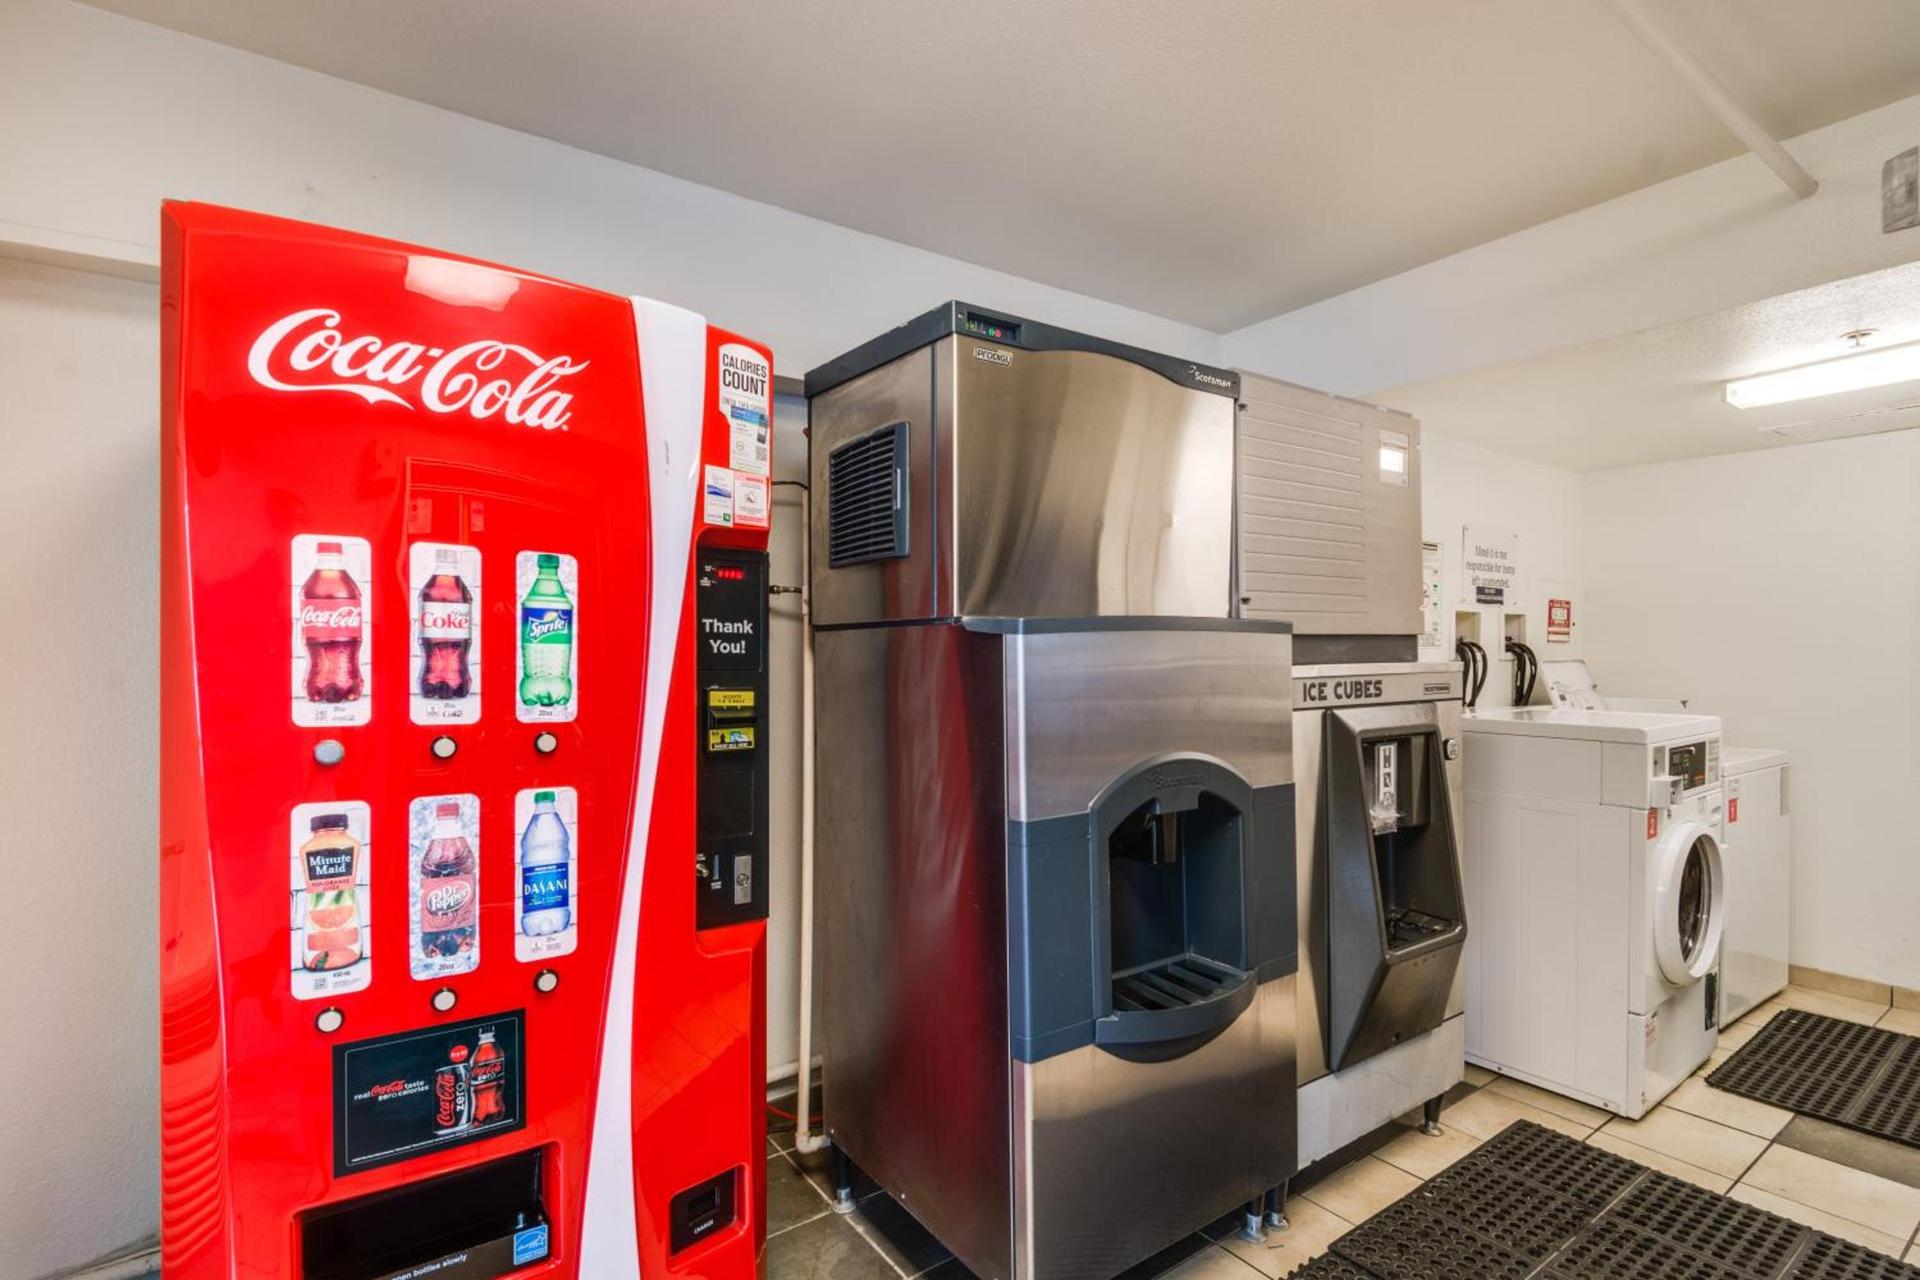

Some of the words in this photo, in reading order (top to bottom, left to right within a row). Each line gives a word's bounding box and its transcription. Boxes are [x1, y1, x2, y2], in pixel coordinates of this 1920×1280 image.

[247, 308, 592, 431] Coca-Cola
[722, 352, 768, 380] CALORIES
[722, 368, 767, 398] COUNT
[1194, 371, 1232, 389] Scotsman
[301, 605, 361, 628] Coca-Cola
[420, 612, 468, 629] Coke
[529, 619, 566, 637] Sprite
[702, 618, 754, 635] Thank
[709, 639, 747, 655] You!
[1302, 681, 1328, 702] ICE
[1333, 679, 1383, 700] CUBES
[309, 852, 352, 868] Minute
[315, 864, 347, 877] Maid
[442, 884, 458, 898] Dr
[524, 878, 567, 896] DASANI
[431, 889, 470, 909] Pepper
[353, 1091, 371, 1101] real
[404, 1080, 425, 1090] taste
[378, 1092, 398, 1102] zero
[397, 1084, 430, 1097] calories
[436, 1072, 456, 1127] Coca-Cola
[455, 1082, 466, 1112] zero
[413, 1262, 441, 1278] bottles
[442, 1253, 468, 1269] slowly
